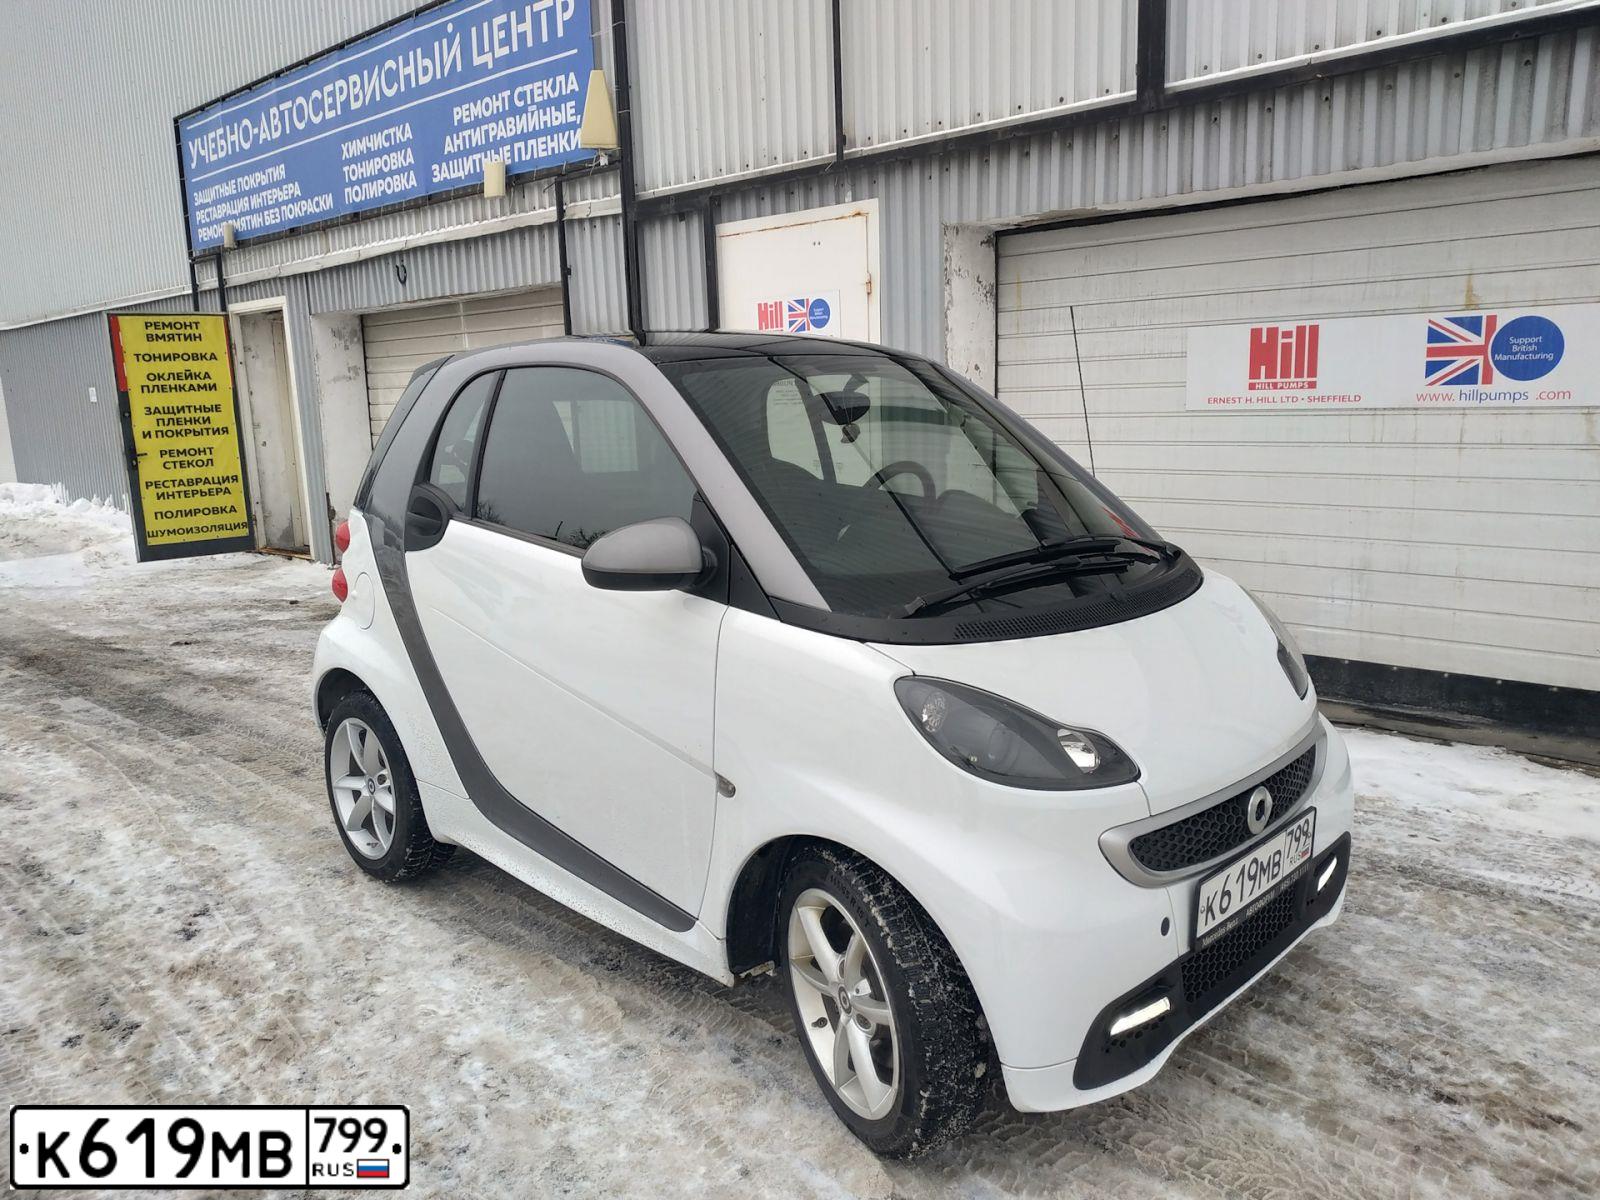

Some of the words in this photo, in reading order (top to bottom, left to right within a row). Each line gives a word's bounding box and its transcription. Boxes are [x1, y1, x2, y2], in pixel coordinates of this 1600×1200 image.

[188, 22, 462, 169] УЧЕБНО-АВТОСЕРВИСНЫЙ
[471, 0, 576, 69] ЦЕНТР
[453, 90, 511, 126] РЕМОНТ
[514, 72, 579, 107] СТЕКЛА
[444, 101, 581, 155] АНТИГРАВИЙНЫЕ,
[341, 122, 413, 160] ХИМЧИСТКА
[343, 147, 414, 183] ТОНИРОВКА
[194, 178, 236, 206] ЗАЩИТНЫЕ
[238, 163, 286, 192] ПОКРЫТИЯ
[344, 170, 417, 204] ПОЛИРОВКА
[196, 197, 250, 225] РЕСТАВРАЦИЯ
[250, 182, 301, 211] ИНТЕРЬЕРА
[198, 222, 226, 242] РЕМОН
[229, 214, 264, 232] МЯТИН
[265, 208, 280, 225] БЕЗ
[281, 193, 333, 219] ПОКРАСКИ
[757, 301, 783, 330] Hill
[144, 321, 200, 331] РЕМОНТ
[146, 333, 202, 342] ВМЯТИН
[1509, 335, 1543, 345] Support
[1249, 324, 1320, 380] Hill
[1512, 344, 1538, 352] British
[133, 352, 218, 363] ТОНИРОВКА
[1494, 352, 1554, 361] Manufacturing
[146, 369, 212, 382] ОКЛЕЙКА
[141, 382, 217, 394] ПЛЕНКАМИ
[1255, 382, 1274, 390] HILL
[1277, 381, 1309, 389] PUMPS
[1207, 396, 1242, 404] ERNEST
[1244, 396, 1254, 404] H.
[1256, 396, 1278, 404] HILL
[1280, 395, 1299, 404] LTD
[1307, 394, 1362, 403] SHEFFIELD
[144, 403, 222, 416] ЗАЩИТНЫЕ
[156, 416, 211, 427] ПЛЕНКИ
[142, 430, 152, 439] И
[155, 426, 229, 439] ПОКРЫТИЯ
[159, 447, 214, 458] РЕМОНТ
[162, 458, 214, 470] СТЕКОЛ
[145, 474, 239, 490] РЕСТАВРАЦИЯ
[156, 487, 231, 501] ИНТЕРЬЕРА
[154, 504, 237, 520] ПОЛИРОВКА
[147, 521, 248, 539] ШУМОИЗОЛЯЦИЯ
[1287, 818, 1309, 859] 799
